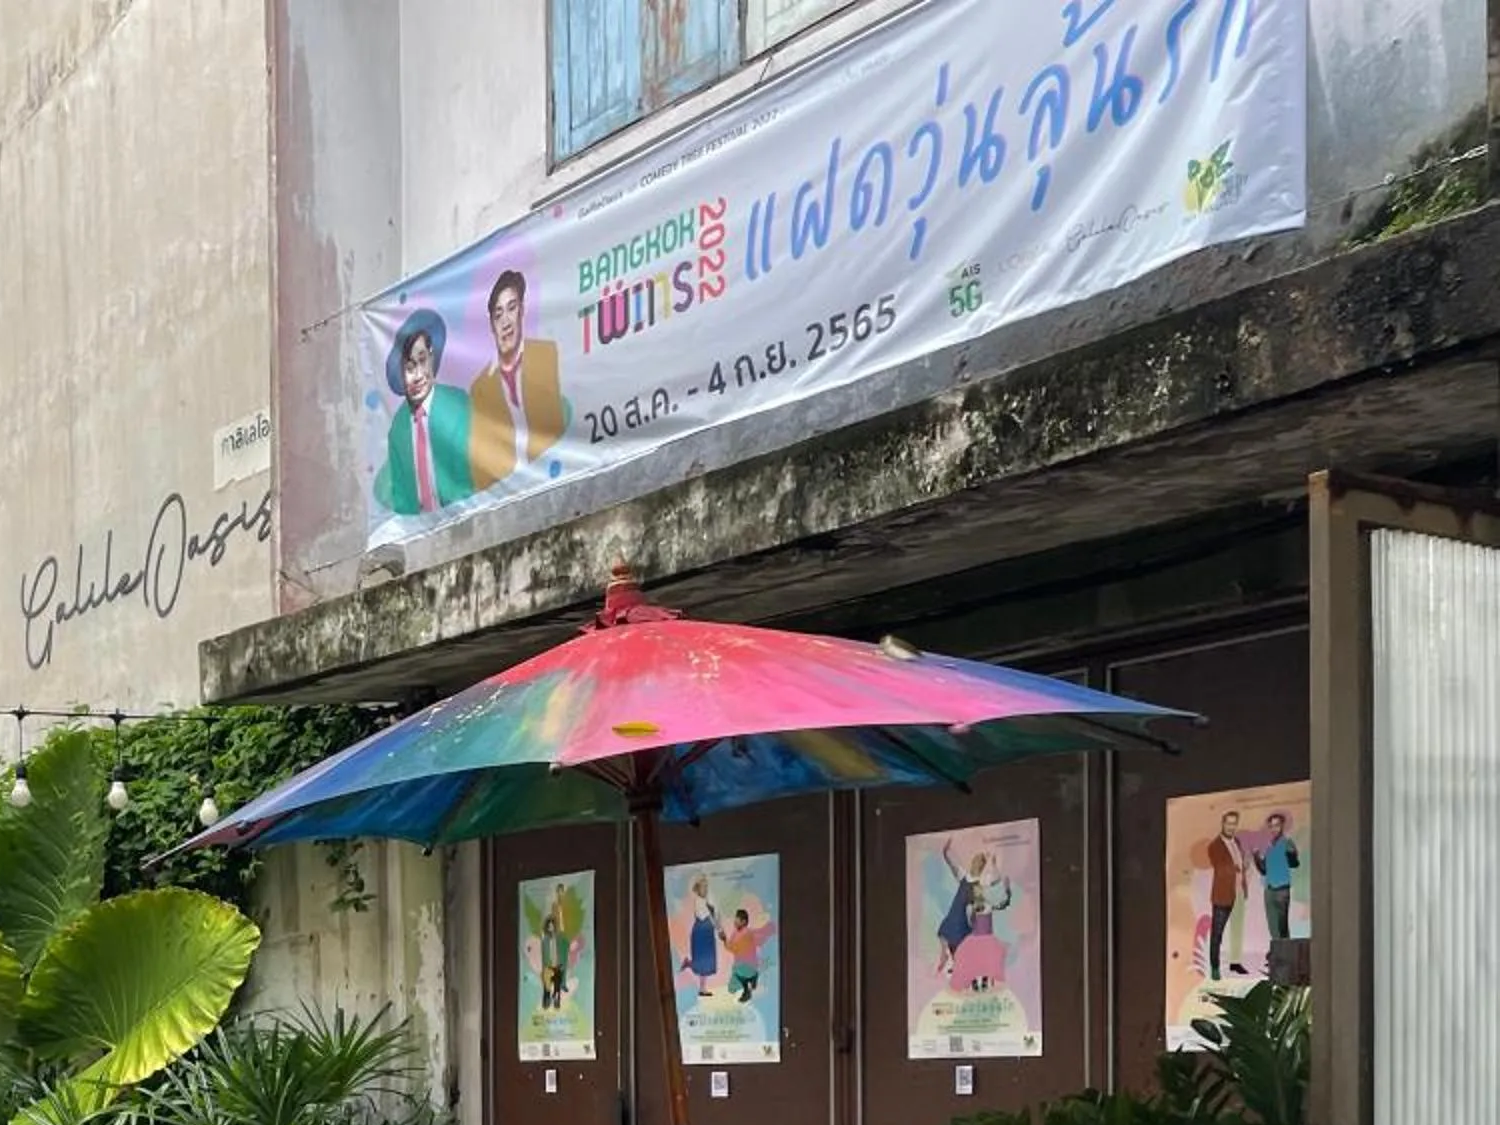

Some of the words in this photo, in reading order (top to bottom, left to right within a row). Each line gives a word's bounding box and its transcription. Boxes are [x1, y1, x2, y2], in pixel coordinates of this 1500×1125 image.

[578, 208, 695, 294] BANGKOK
[698, 197, 727, 304] 2022
[961, 263, 980, 279] AIS
[950, 281, 983, 318] 5G
[584, 405, 618, 443] 20
[625, 386, 678, 430] ส.ค.
[708, 362, 726, 395] 4
[734, 340, 796, 387] ก.ย.
[805, 294, 897, 361] 2565
